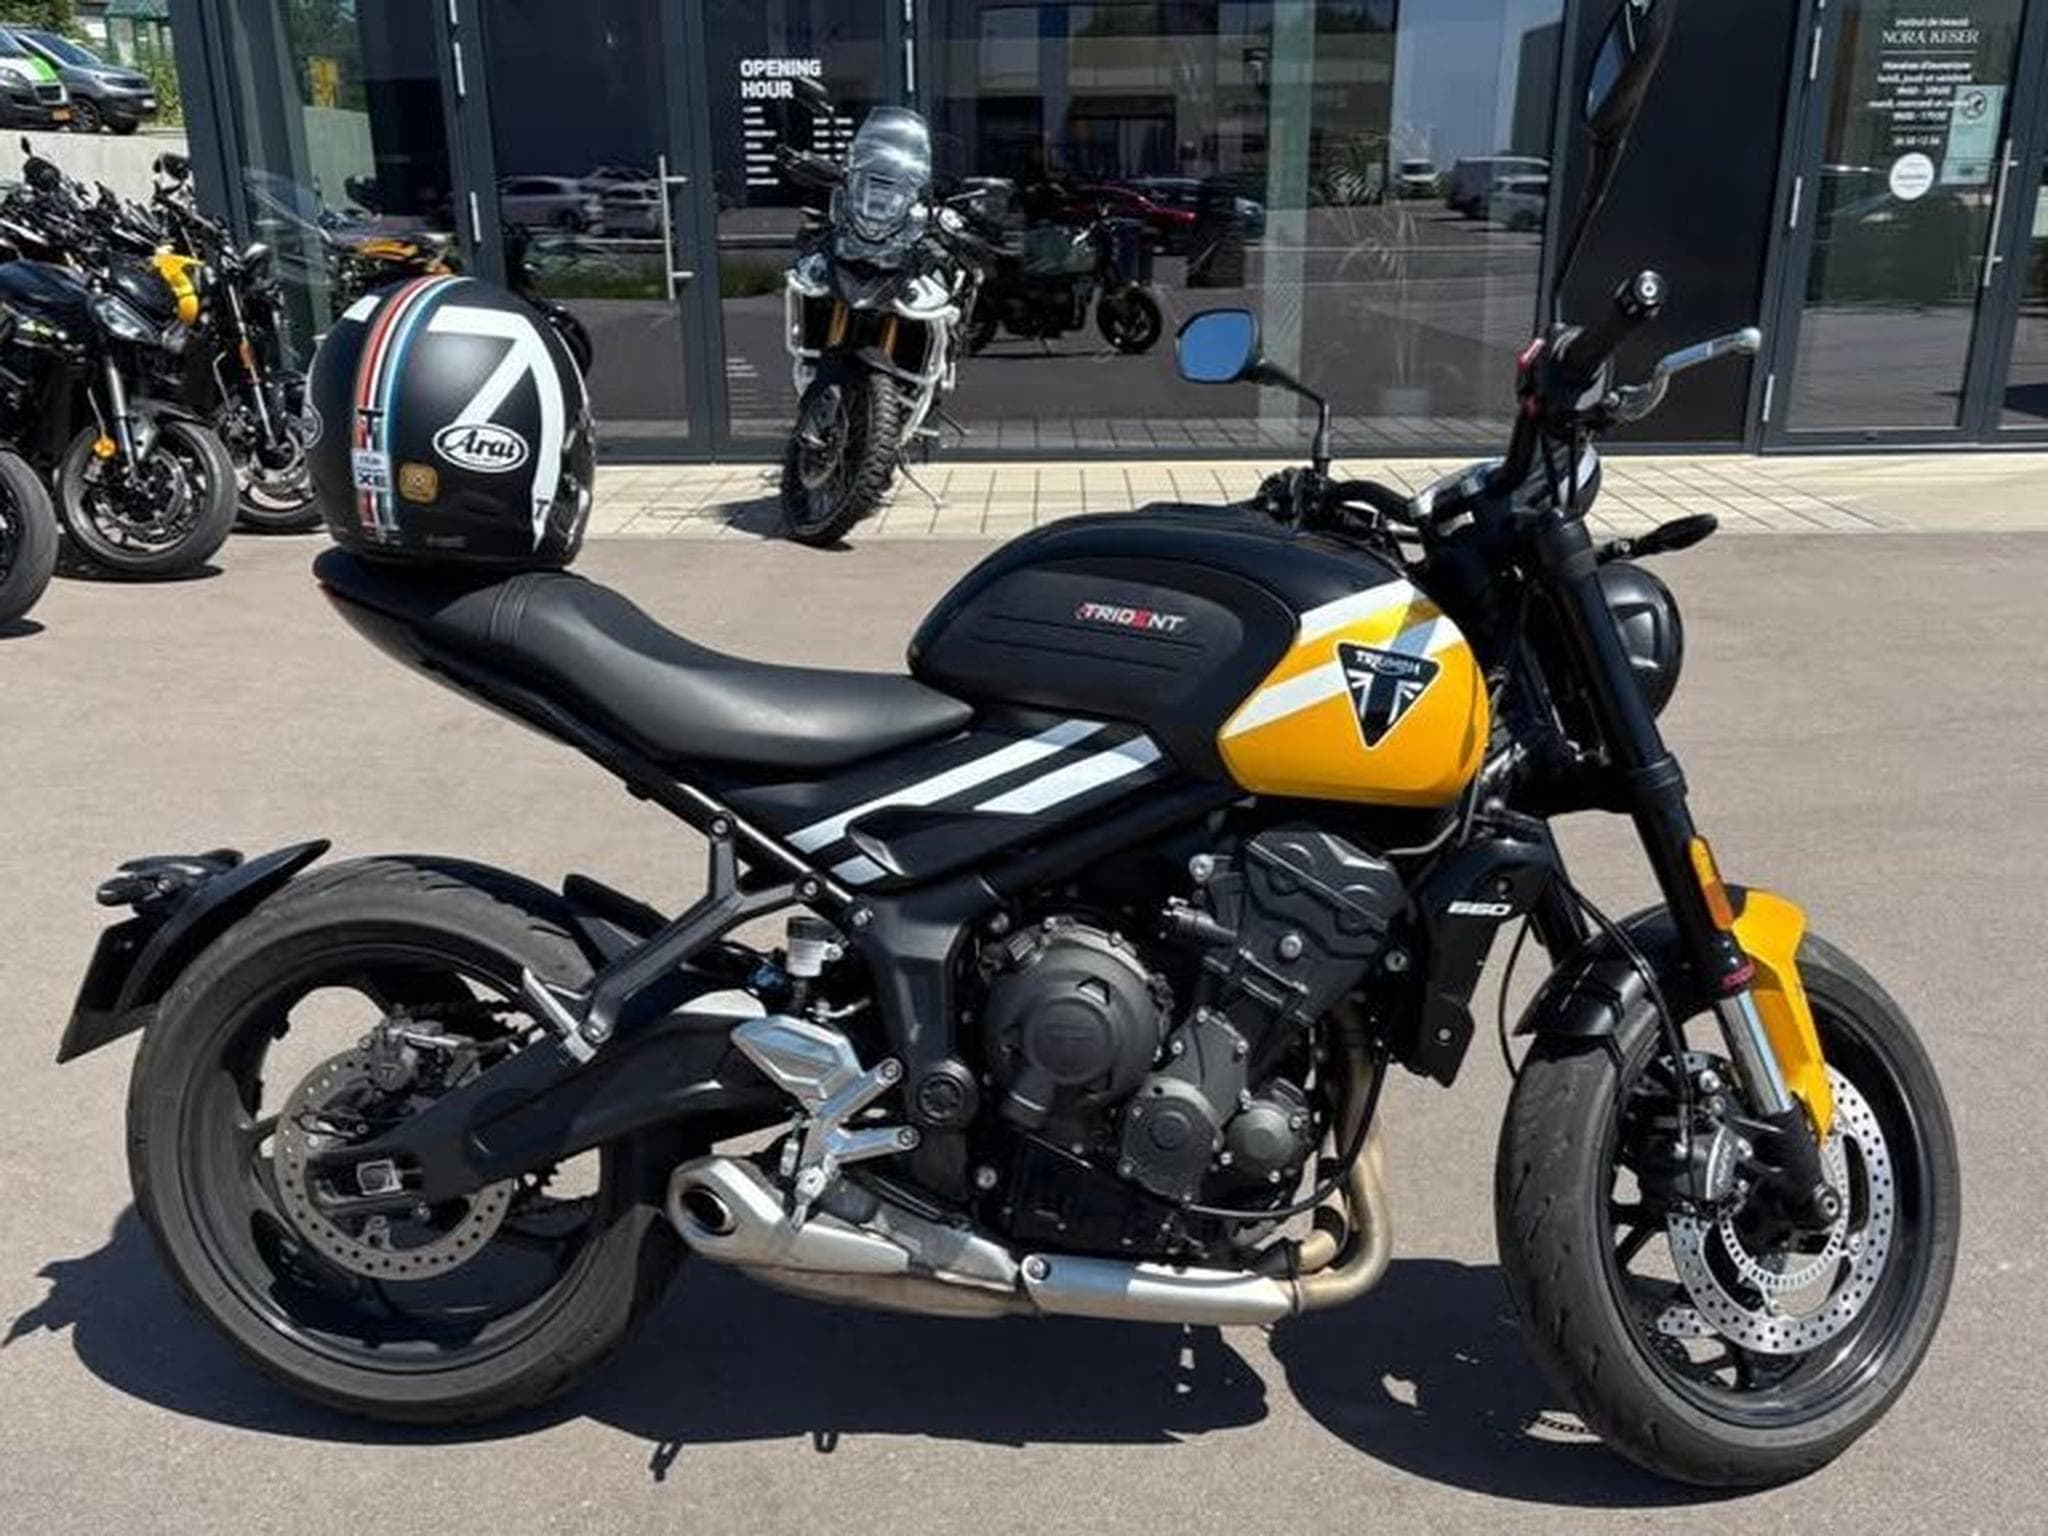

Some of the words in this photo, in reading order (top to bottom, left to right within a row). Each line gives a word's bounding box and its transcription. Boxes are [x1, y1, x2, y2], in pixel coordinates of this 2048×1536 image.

[740, 59, 821, 77] OPENING
[741, 81, 794, 98] HOUR
[444, 429, 517, 459] Arai
[1076, 602, 1186, 631] TRIDENT
